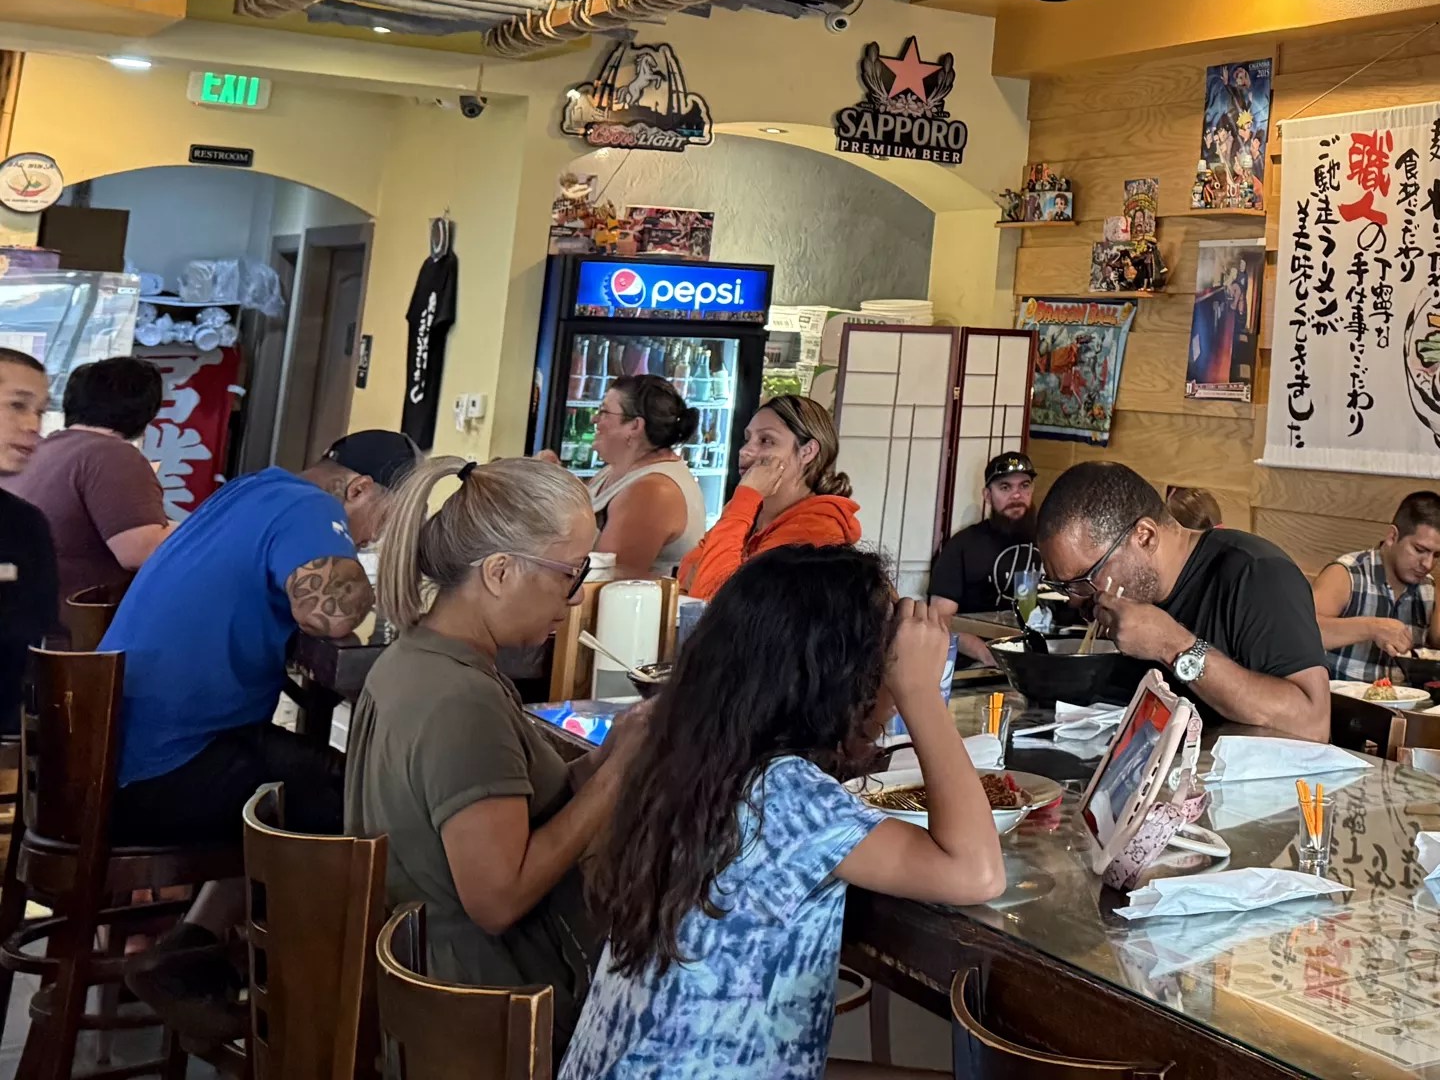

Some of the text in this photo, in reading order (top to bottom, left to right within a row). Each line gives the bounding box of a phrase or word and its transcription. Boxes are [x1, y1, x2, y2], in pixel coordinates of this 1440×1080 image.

[588, 124, 687, 149] Coors LIGHT
[840, 109, 967, 150] SAPPORO
[193, 149, 249, 162] RESTROOM
[840, 140, 960, 163] PREMIUM BEER
[652, 278, 743, 310] pepsi
[1035, 301, 1119, 326] DRAGON BALL
